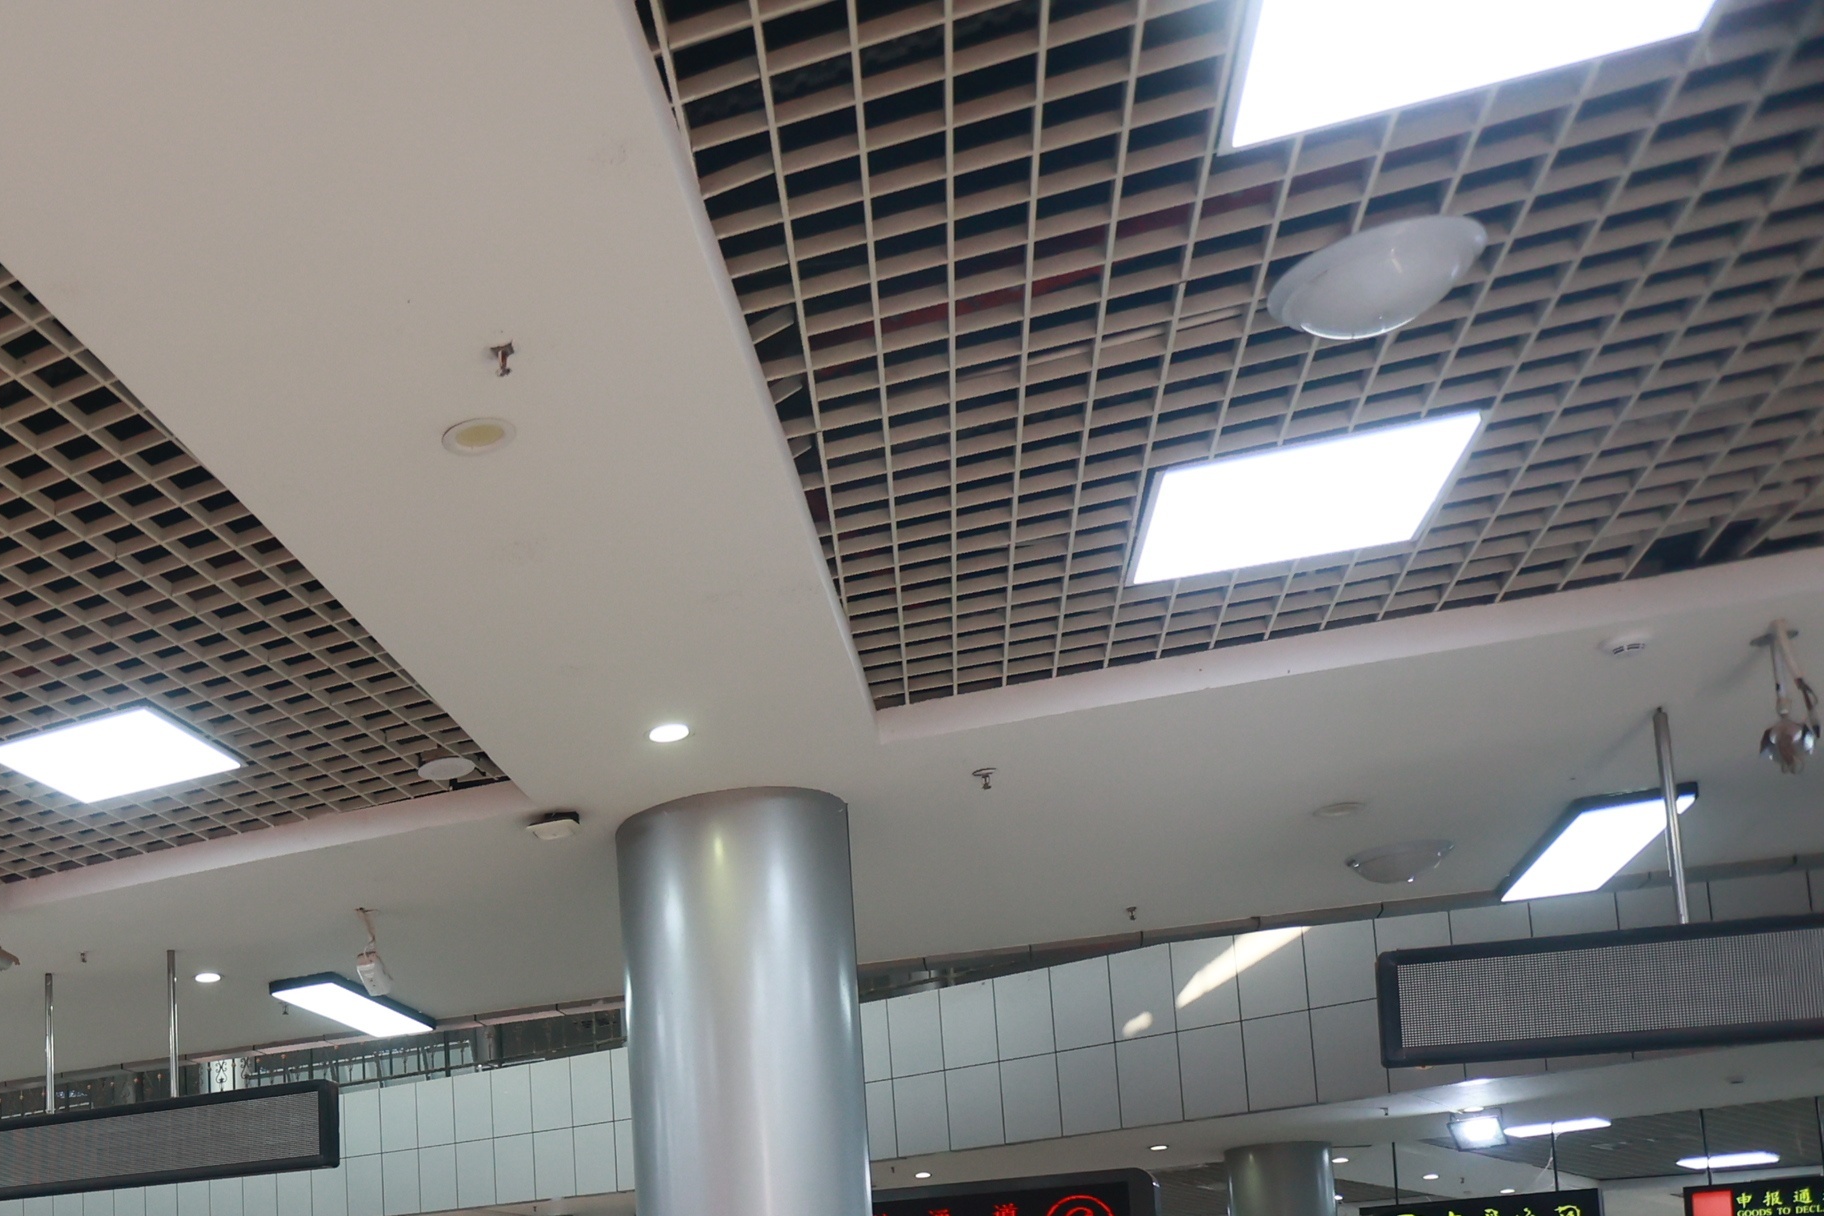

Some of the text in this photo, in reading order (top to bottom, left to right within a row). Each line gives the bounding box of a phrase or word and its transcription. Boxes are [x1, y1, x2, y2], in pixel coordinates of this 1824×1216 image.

[1736, 1187, 1824, 1208] 申报通
[1777, 1207, 1791, 1215] TO
[1796, 1205, 1824, 1214] DECL
